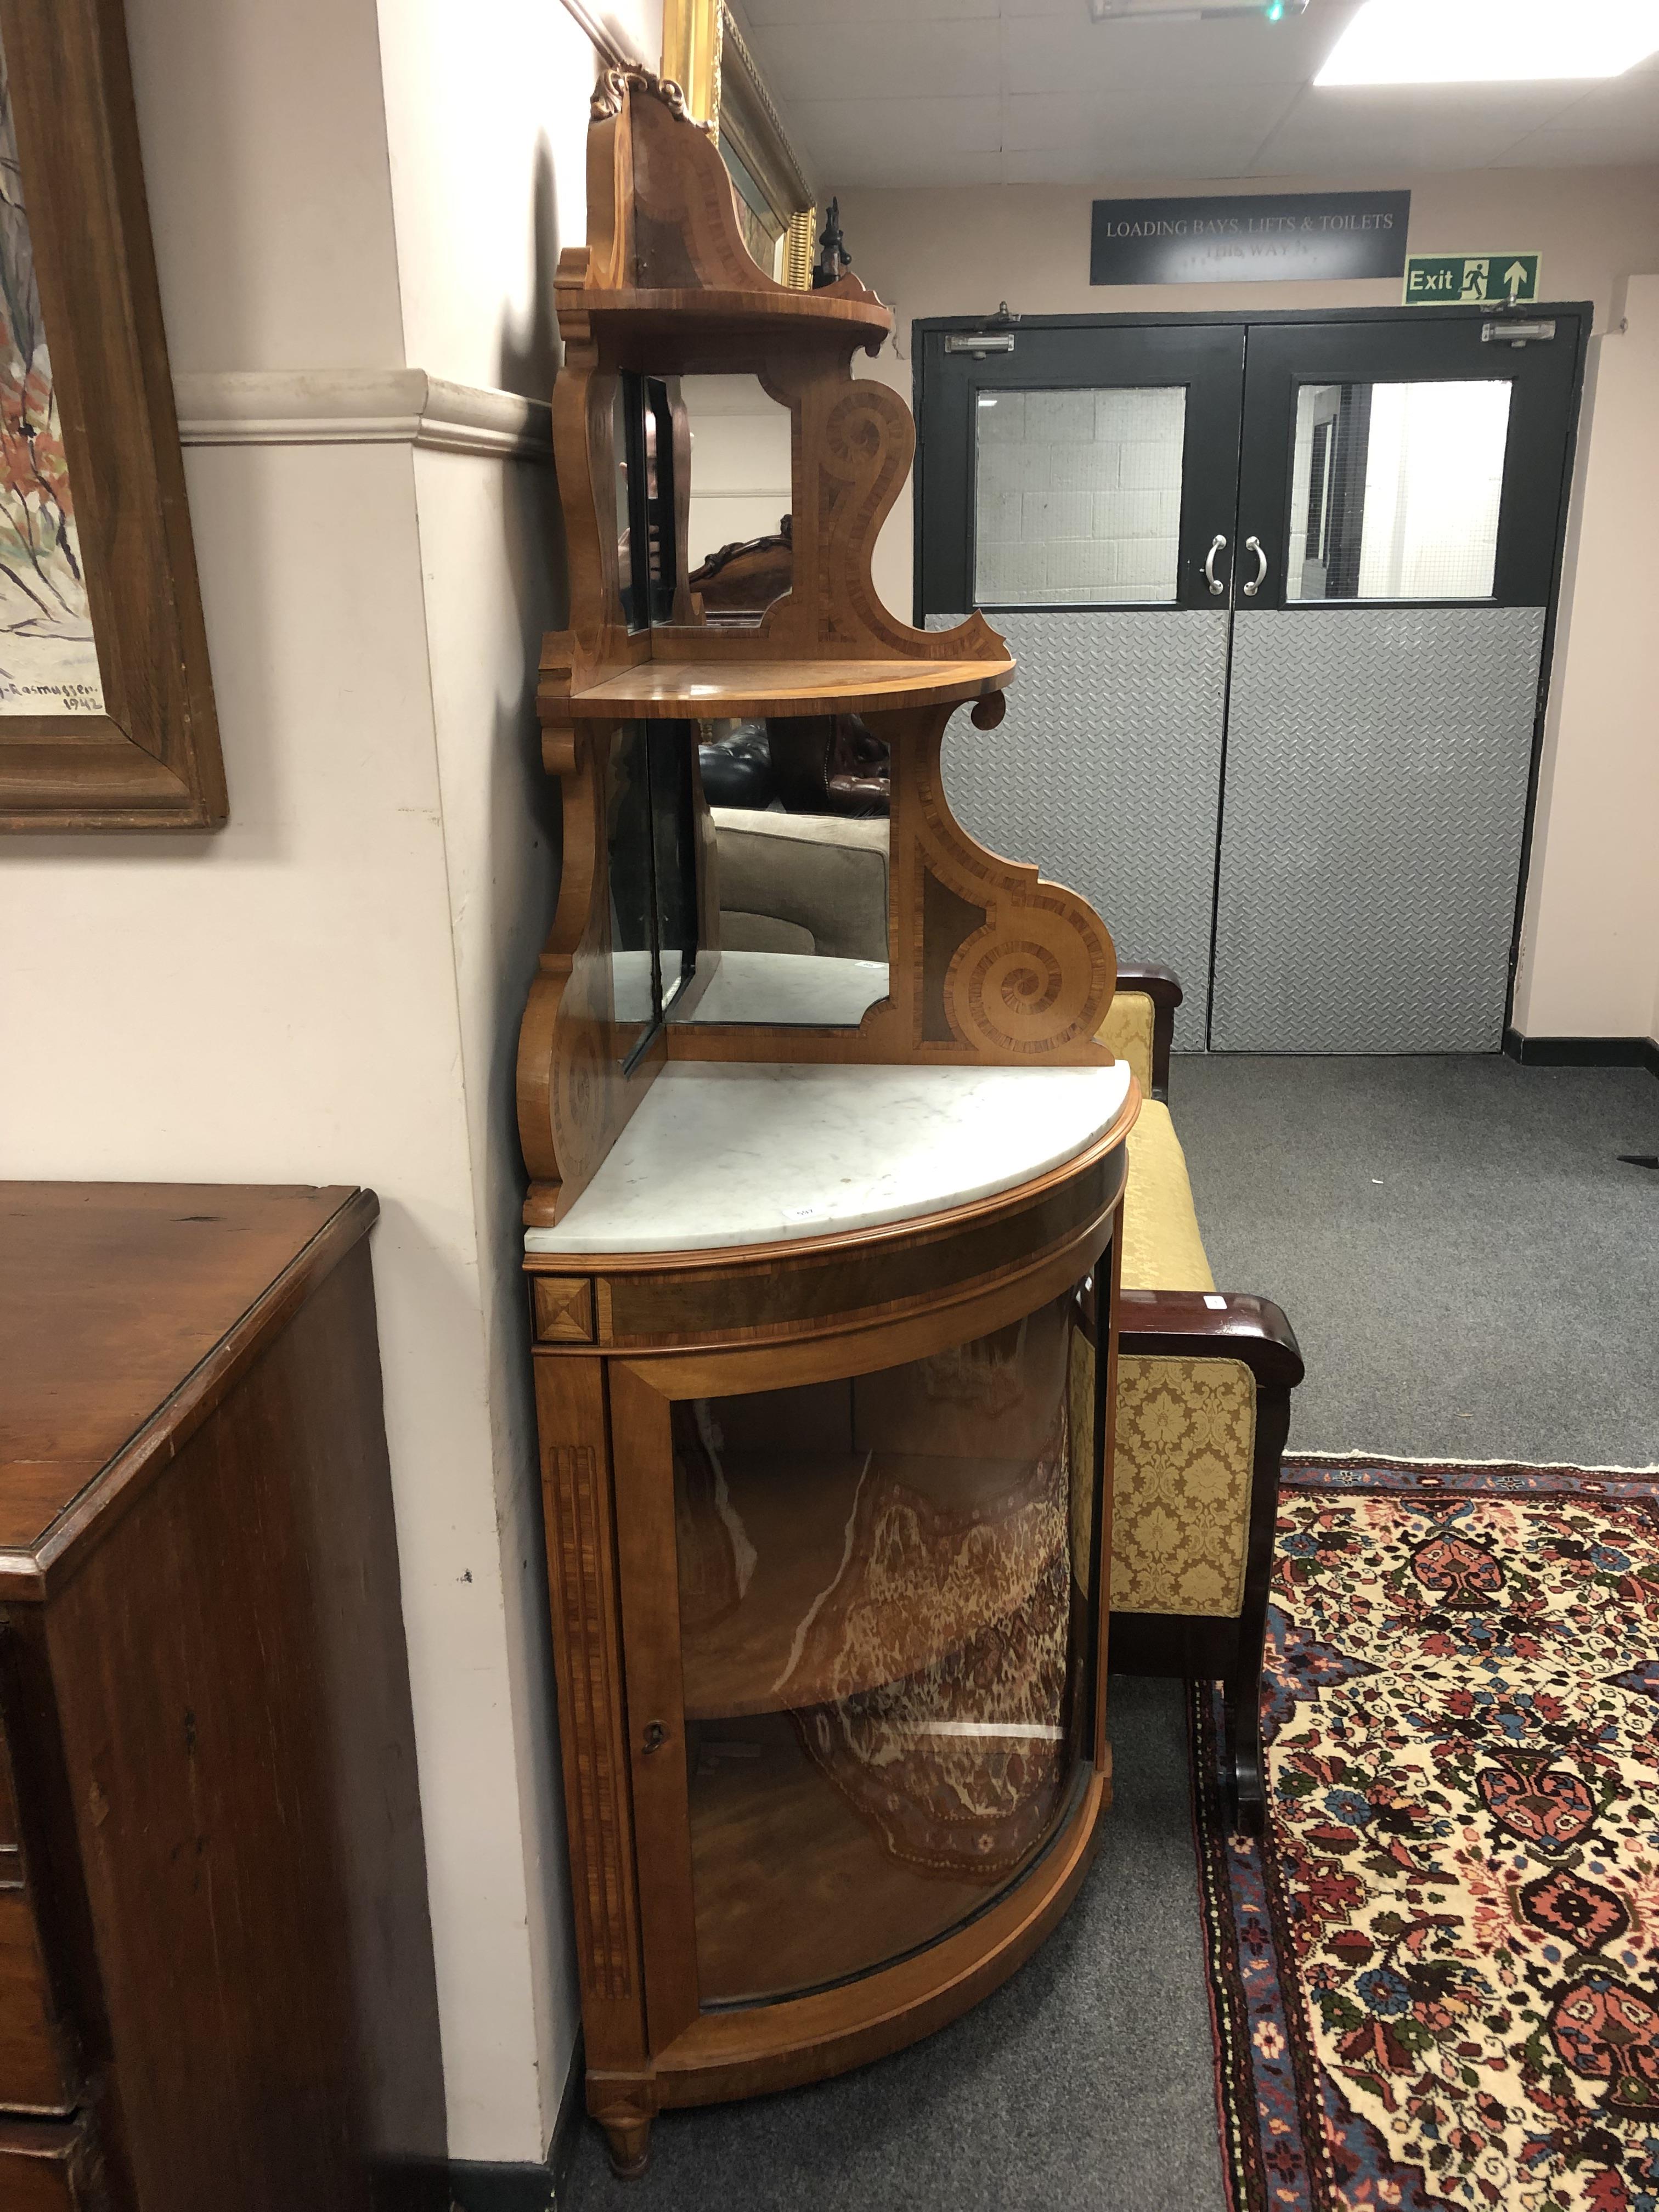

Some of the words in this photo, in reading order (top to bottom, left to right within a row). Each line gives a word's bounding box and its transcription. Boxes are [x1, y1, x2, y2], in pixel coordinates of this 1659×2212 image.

[1107, 219, 1187, 237] LOADING
[1248, 217, 1296, 233] LIFTS
[1300, 216, 1314, 231] &
[1319, 213, 1394, 230] TOILETS
[1249, 241, 1290, 257] WAY
[1409, 269, 1453, 290] Exit
[63, 698, 103, 711] 1942
